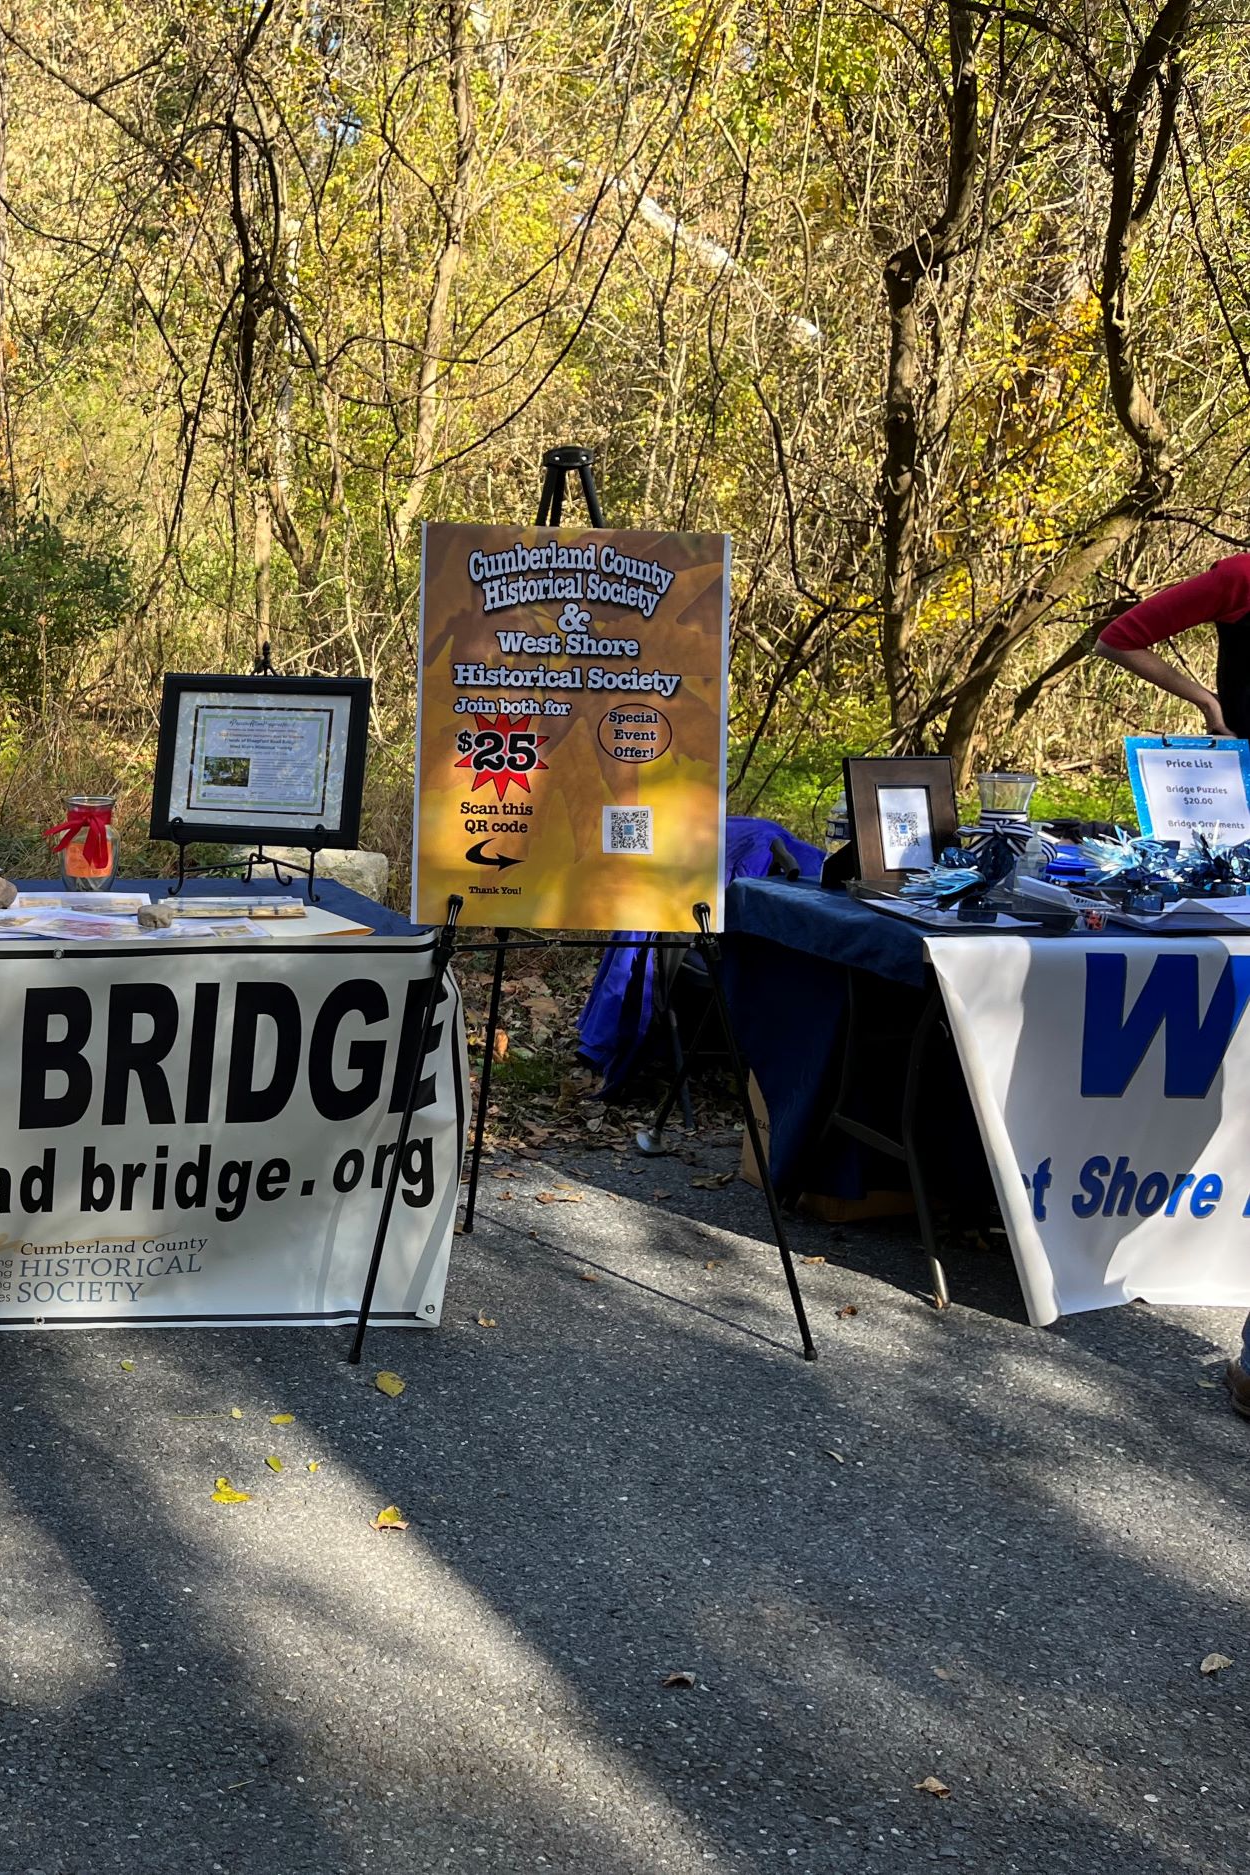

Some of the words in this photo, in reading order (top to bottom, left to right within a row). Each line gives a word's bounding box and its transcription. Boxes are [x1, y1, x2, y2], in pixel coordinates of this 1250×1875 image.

[469, 541, 597, 582] Cumberland
[601, 547, 674, 593] County
[482, 571, 583, 611] Historical
[586, 574, 660, 617] Society
[557, 603, 591, 633] &
[497, 631, 561, 654] West
[565, 633, 639, 657] Shore
[454, 664, 582, 689] Historical
[587, 667, 680, 697] Society
[454, 698, 497, 714] Join
[499, 699, 542, 714] both
[543, 701, 571, 716] for
[609, 712, 658, 726] Special
[614, 729, 656, 740] Event
[457, 730, 537, 772] $25
[614, 746, 654, 758] Offer!
[1166, 759, 1193, 768] Price
[1194, 758, 1213, 769] List
[1166, 785, 1195, 795] Bridge
[1197, 786, 1228, 795] Puzzles
[461, 802, 499, 815] Scan
[502, 803, 533, 816] this
[1183, 797, 1213, 805] $20.00
[464, 820, 489, 833] QR
[492, 821, 528, 833] code
[1168, 819, 1197, 829] Bridge
[469, 886, 499, 895] Thank
[501, 887, 522, 895] You!
[18, 977, 448, 1130] BRIDGE
[1071, 1155, 1223, 1219] Shore
[21, 1240, 136, 1256] Cumberland
[142, 1238, 208, 1254] County
[18, 1254, 203, 1278] HISTORICAL
[17, 1281, 145, 1303] SOCIETY
